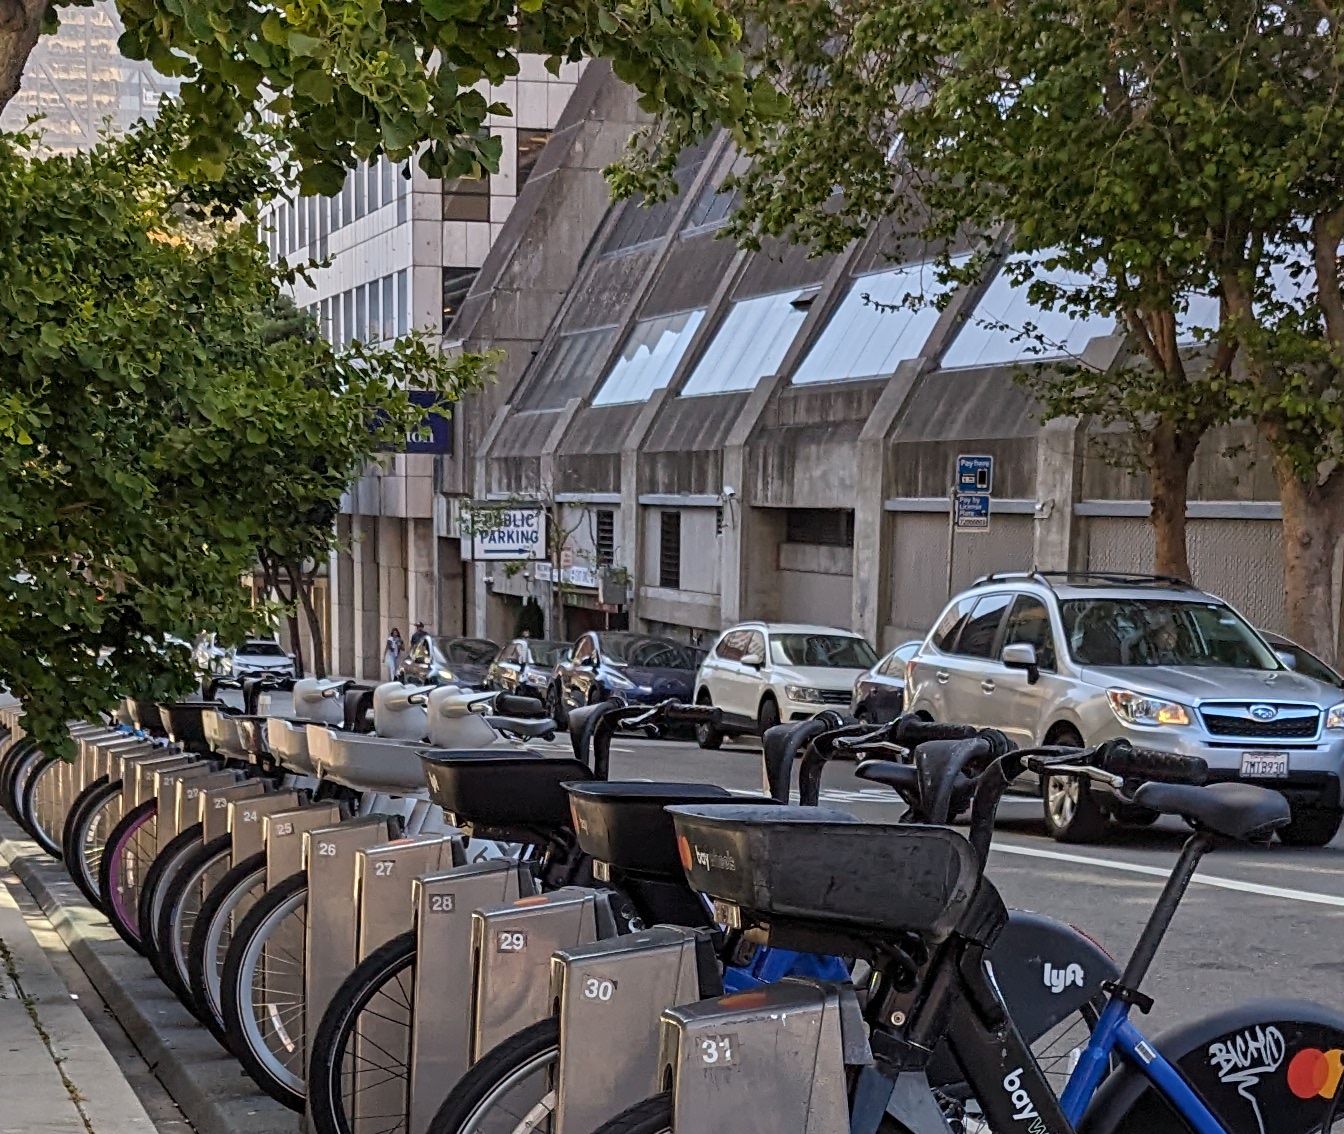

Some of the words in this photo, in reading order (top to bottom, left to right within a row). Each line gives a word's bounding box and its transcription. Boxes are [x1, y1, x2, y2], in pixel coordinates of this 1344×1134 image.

[479, 529, 539, 545] PARKING
[187, 789, 199, 799] 22
[213, 798, 227, 809] 23
[243, 811, 257, 822] 24
[277, 823, 292, 836] 25
[319, 843, 336, 856] 26
[375, 861, 393, 876] 27
[432, 896, 453, 911] 28
[500, 933, 524, 950] 29
[1043, 962, 1084, 993] lyft
[584, 978, 613, 1001] 30
[701, 1037, 732, 1064] 31
